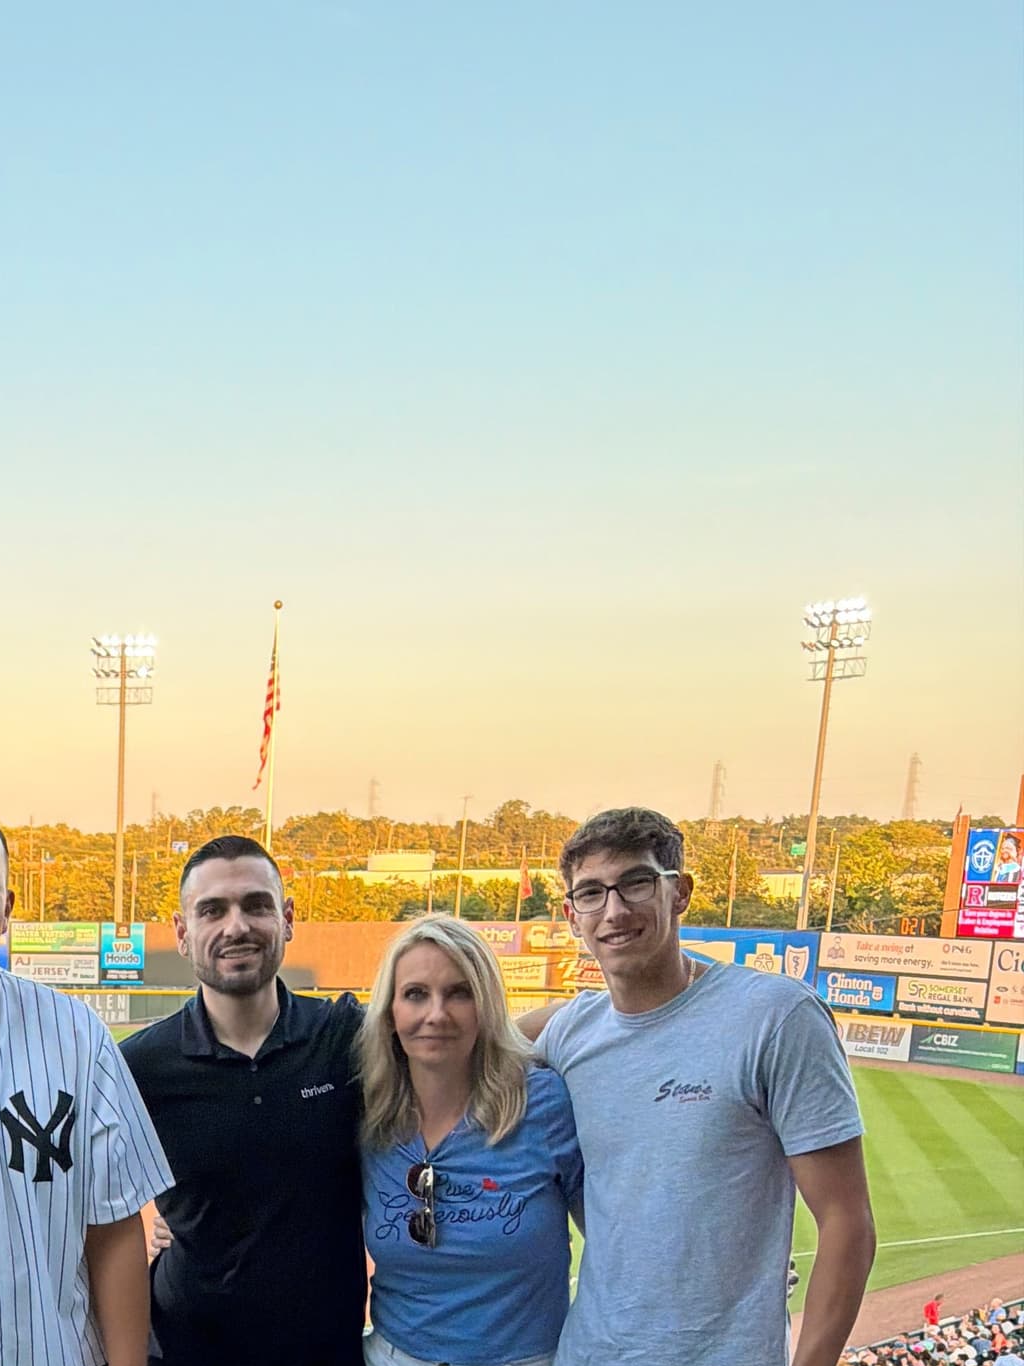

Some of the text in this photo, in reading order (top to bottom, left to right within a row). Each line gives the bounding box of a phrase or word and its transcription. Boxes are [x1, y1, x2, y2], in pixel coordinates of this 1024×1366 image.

[114, 943, 131, 952] VIP
[904, 944, 914, 953] at
[106, 953, 139, 964] Honda
[854, 953, 879, 966] saving
[880, 956, 901, 965] more
[32, 967, 70, 976] JERSEY
[827, 972, 872, 990] Clinton
[928, 985, 967, 995] SOMERSET
[827, 988, 870, 1005] Honda
[927, 994, 950, 1003] REGAL
[846, 1022, 906, 1047] IBEW
[933, 1034, 960, 1047] CBIZ
[854, 1044, 874, 1053] Local
